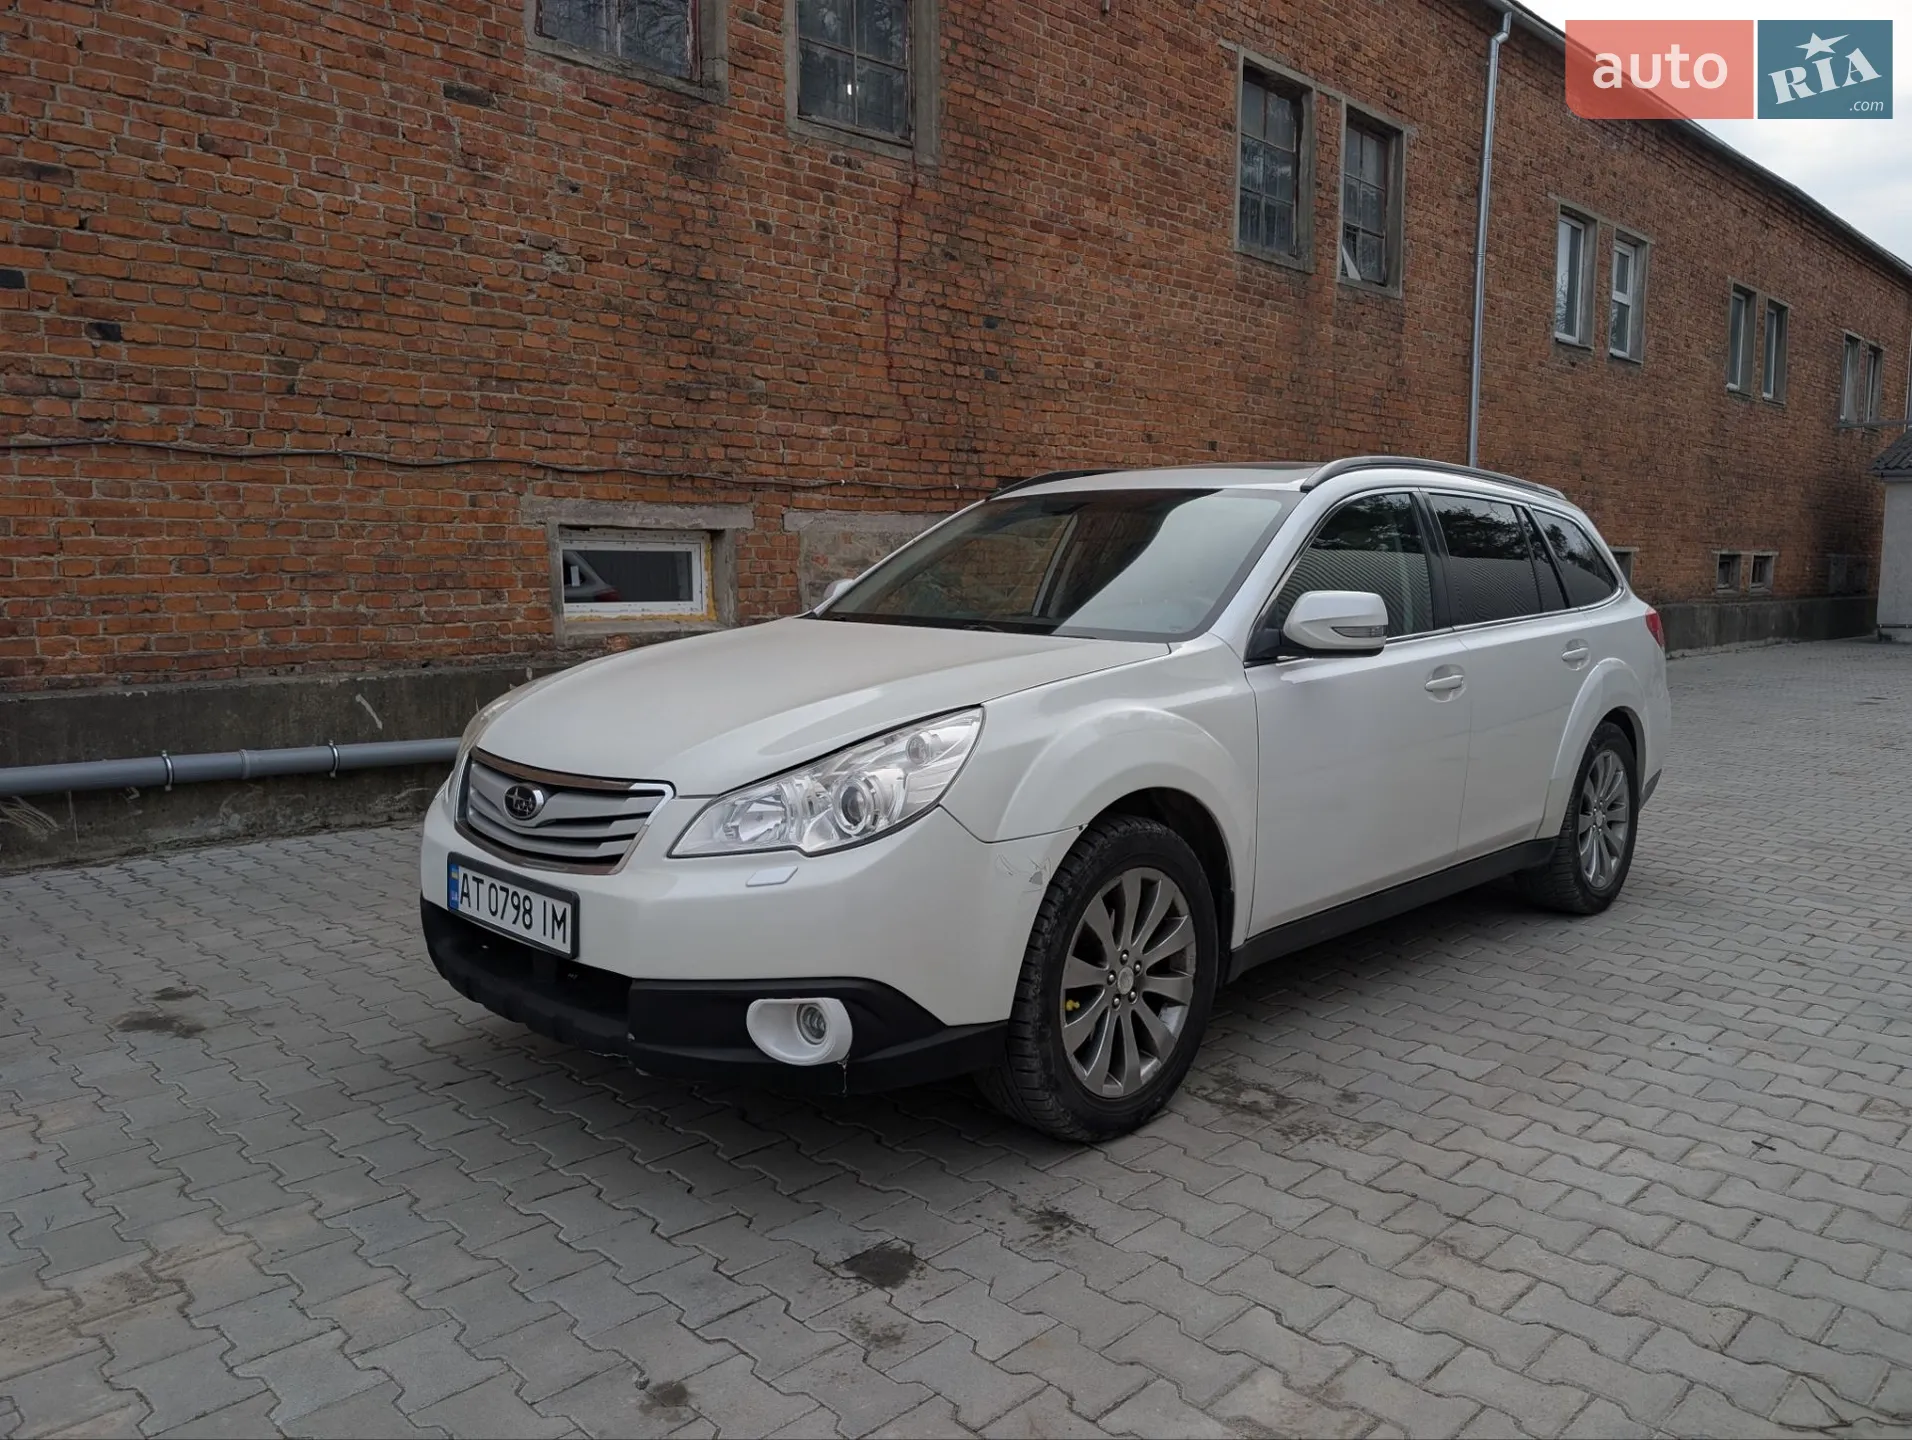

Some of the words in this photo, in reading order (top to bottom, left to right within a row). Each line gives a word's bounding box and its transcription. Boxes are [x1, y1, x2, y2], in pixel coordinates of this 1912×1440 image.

[460, 873, 484, 911] AT
[488, 882, 533, 930] 0798
[543, 900, 567, 944] IM
